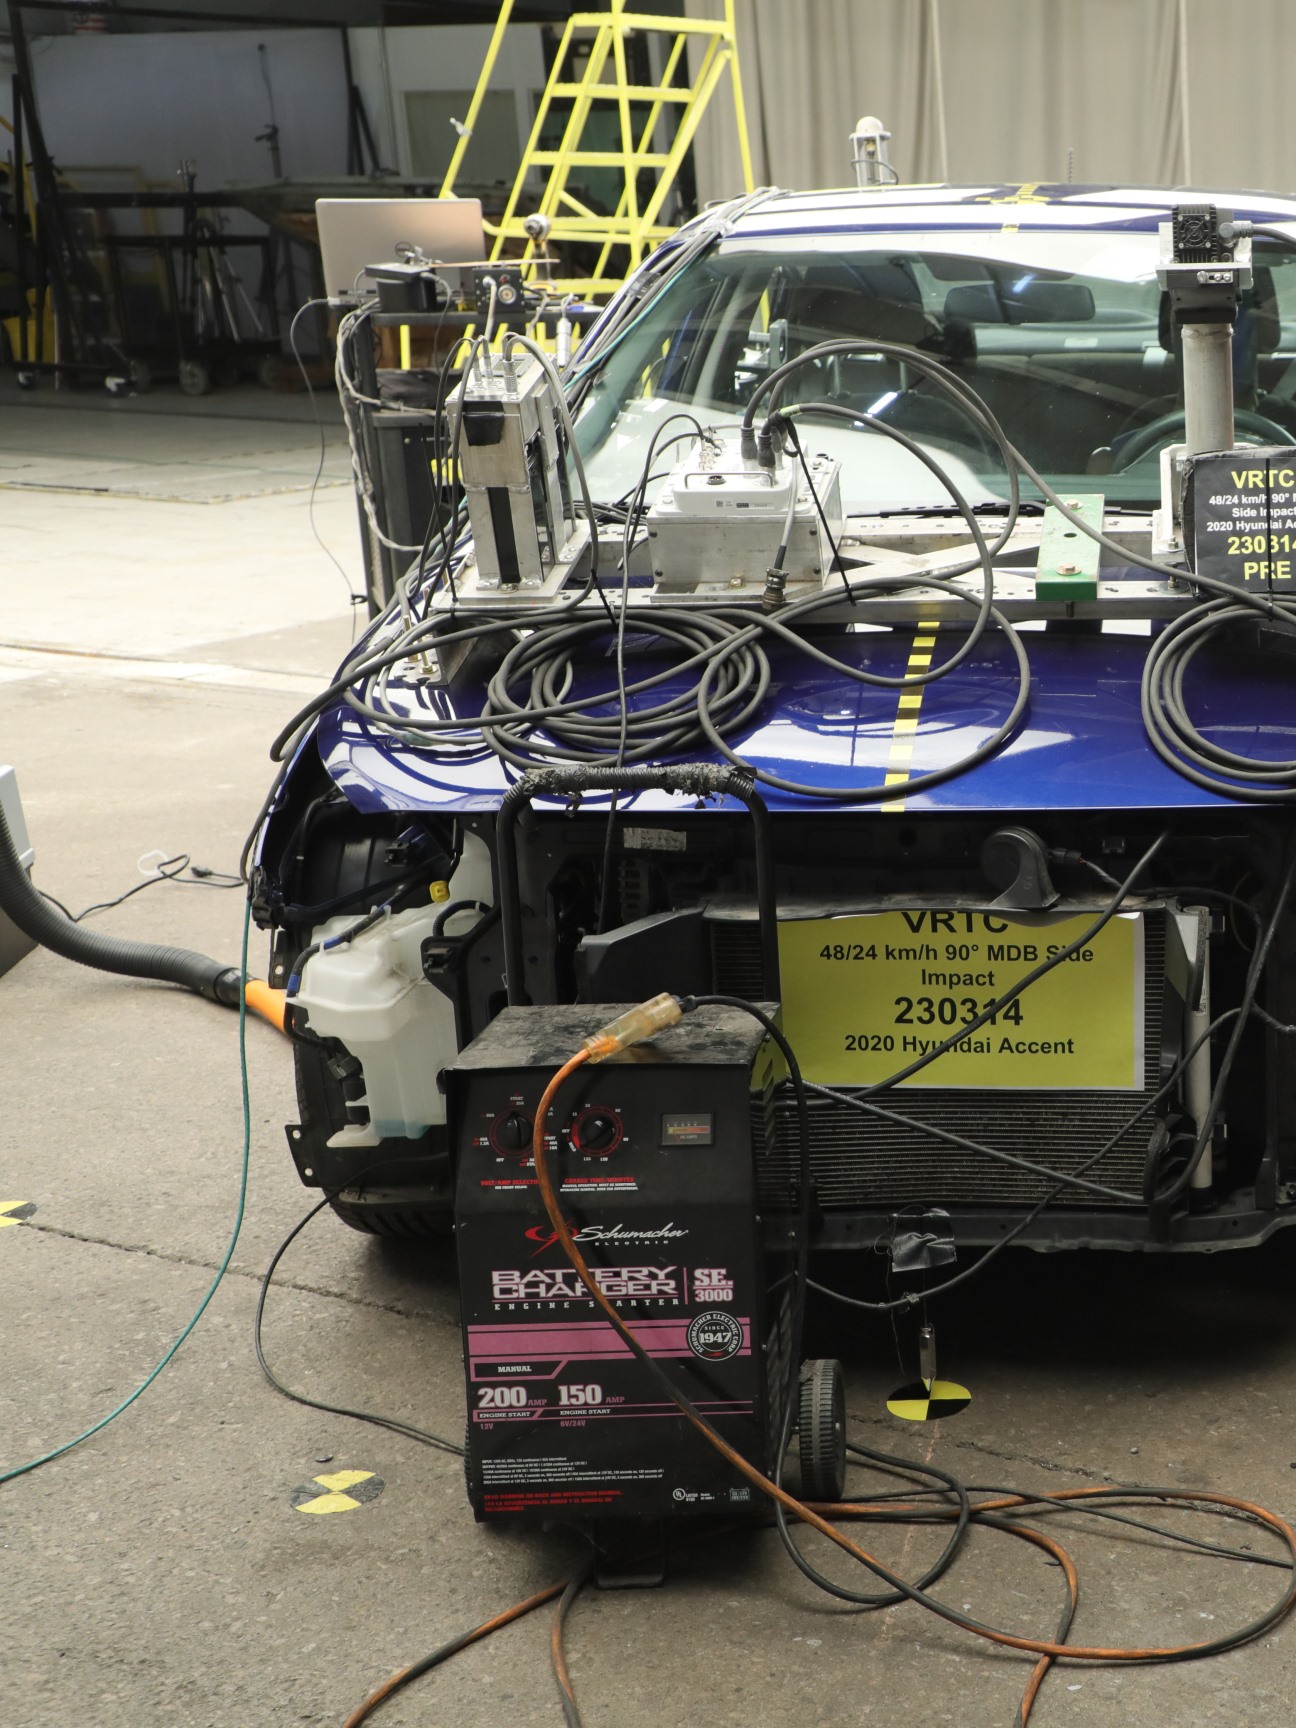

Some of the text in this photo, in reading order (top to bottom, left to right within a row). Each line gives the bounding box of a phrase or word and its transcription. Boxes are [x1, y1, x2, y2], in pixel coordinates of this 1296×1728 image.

[1231, 469, 1295, 489] VRTC
[1209, 495, 1240, 505] 48/24
[1232, 507, 1257, 518] Side
[1206, 521, 1233, 531] 2020
[1243, 560, 1292, 580] PRE
[901, 910, 1009, 933] VRTC
[819, 944, 878, 961] 48/24
[884, 944, 938, 961] km/h
[945, 944, 979, 961] 90°
[987, 944, 1039, 962] MDB
[921, 969, 995, 989] Impact
[894, 996, 1024, 1026] 230314
[844, 1034, 895, 1052] 2020
[998, 1037, 1075, 1054] Accent
[572, 1222, 687, 1241] Schumacher
[494, 1298, 679, 1311] ENGINE SARTER
[694, 1288, 734, 1302] 3000
[691, 1314, 712, 1353] SCHUMACHER
[712, 1313, 739, 1335] ELECTRIC
[699, 1332, 732, 1344] 1947
[497, 1365, 532, 1373] MANUAL
[477, 1386, 527, 1408] 200
[558, 1384, 625, 1406] 150 AMP
